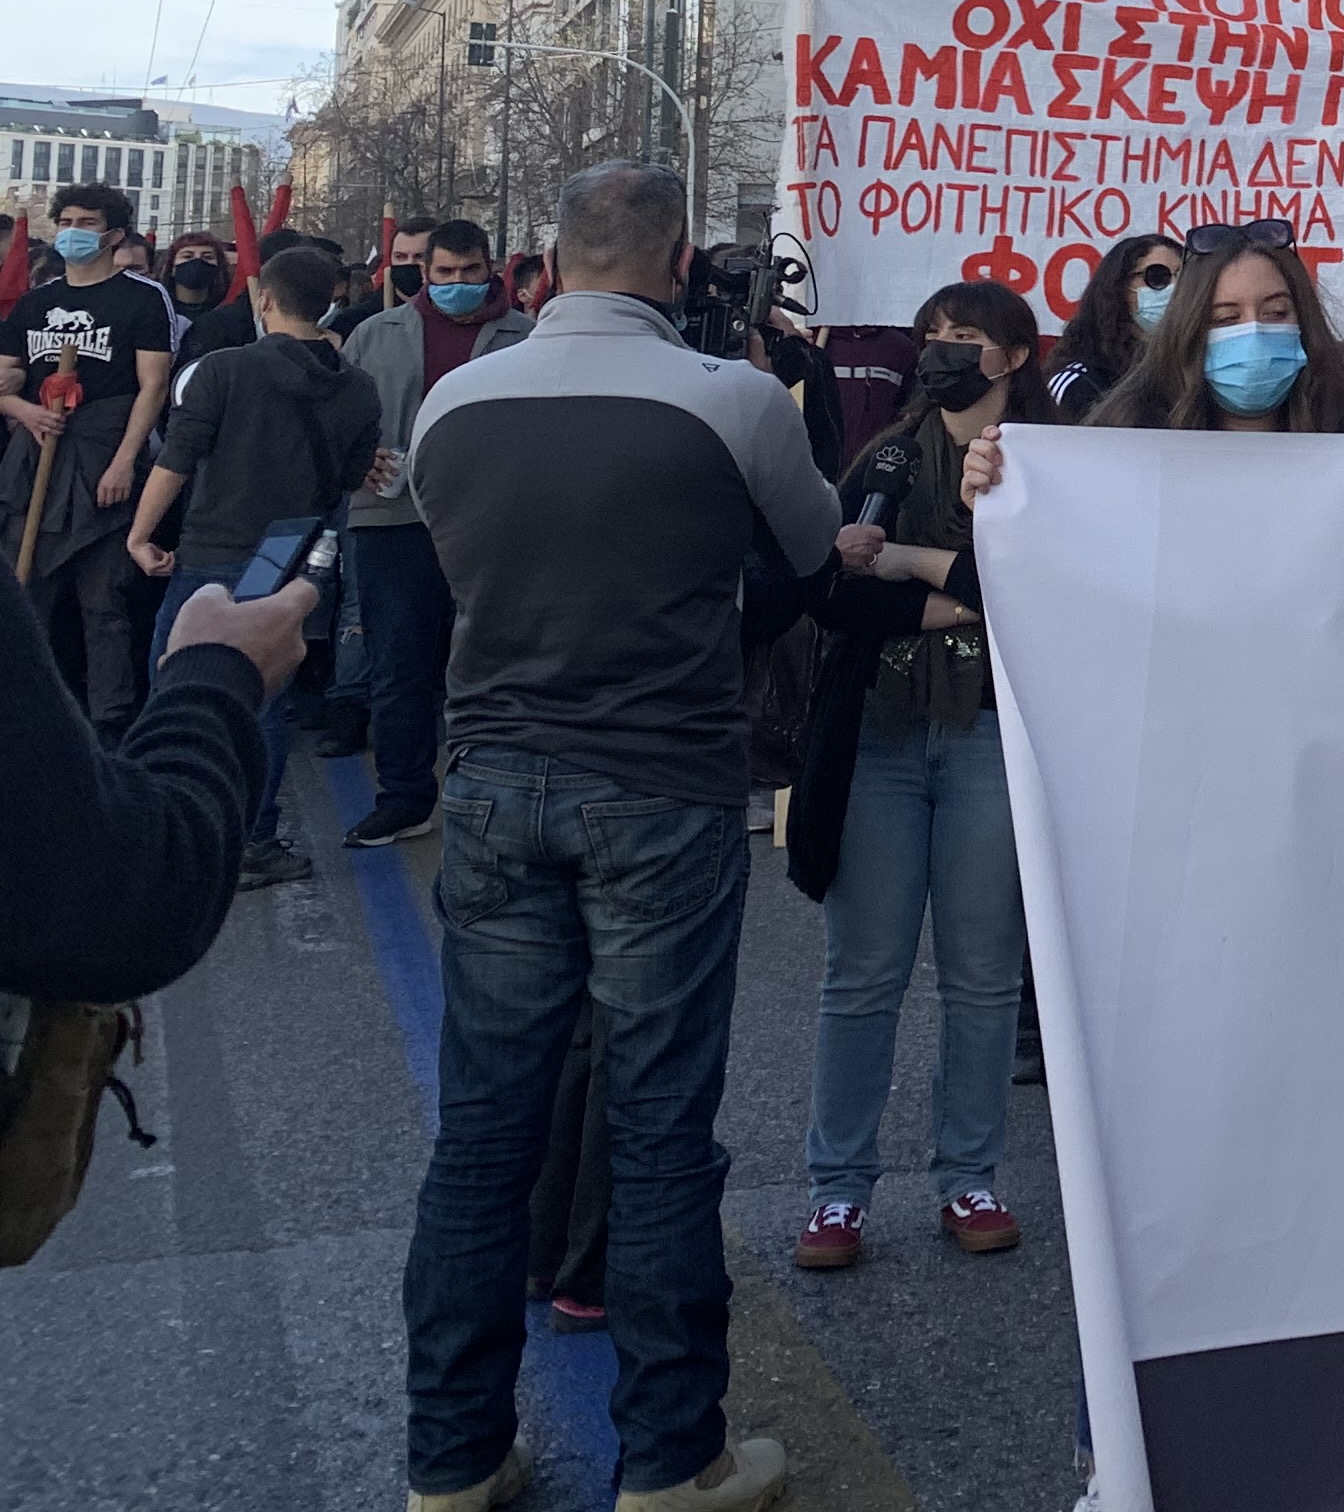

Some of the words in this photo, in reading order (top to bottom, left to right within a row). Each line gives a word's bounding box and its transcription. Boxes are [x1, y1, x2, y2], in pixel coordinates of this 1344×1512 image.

[1108, 6, 1308, 70] ΣΤΗΝ
[796, 34, 1033, 115] ΚΑΜΙΑ
[1048, 53, 1301, 126] ΣΚΕΨΗ
[793, 116, 839, 171] ΤΑ
[857, 115, 1238, 186] ΠΑΝΕΠΙΣΤΗΜΙΑ
[789, 180, 842, 241] ΤΟ
[859, 179, 1131, 239] ΦΟΙΤΗΤΙΚΟ
[26, 326, 112, 364] LONSDALE
